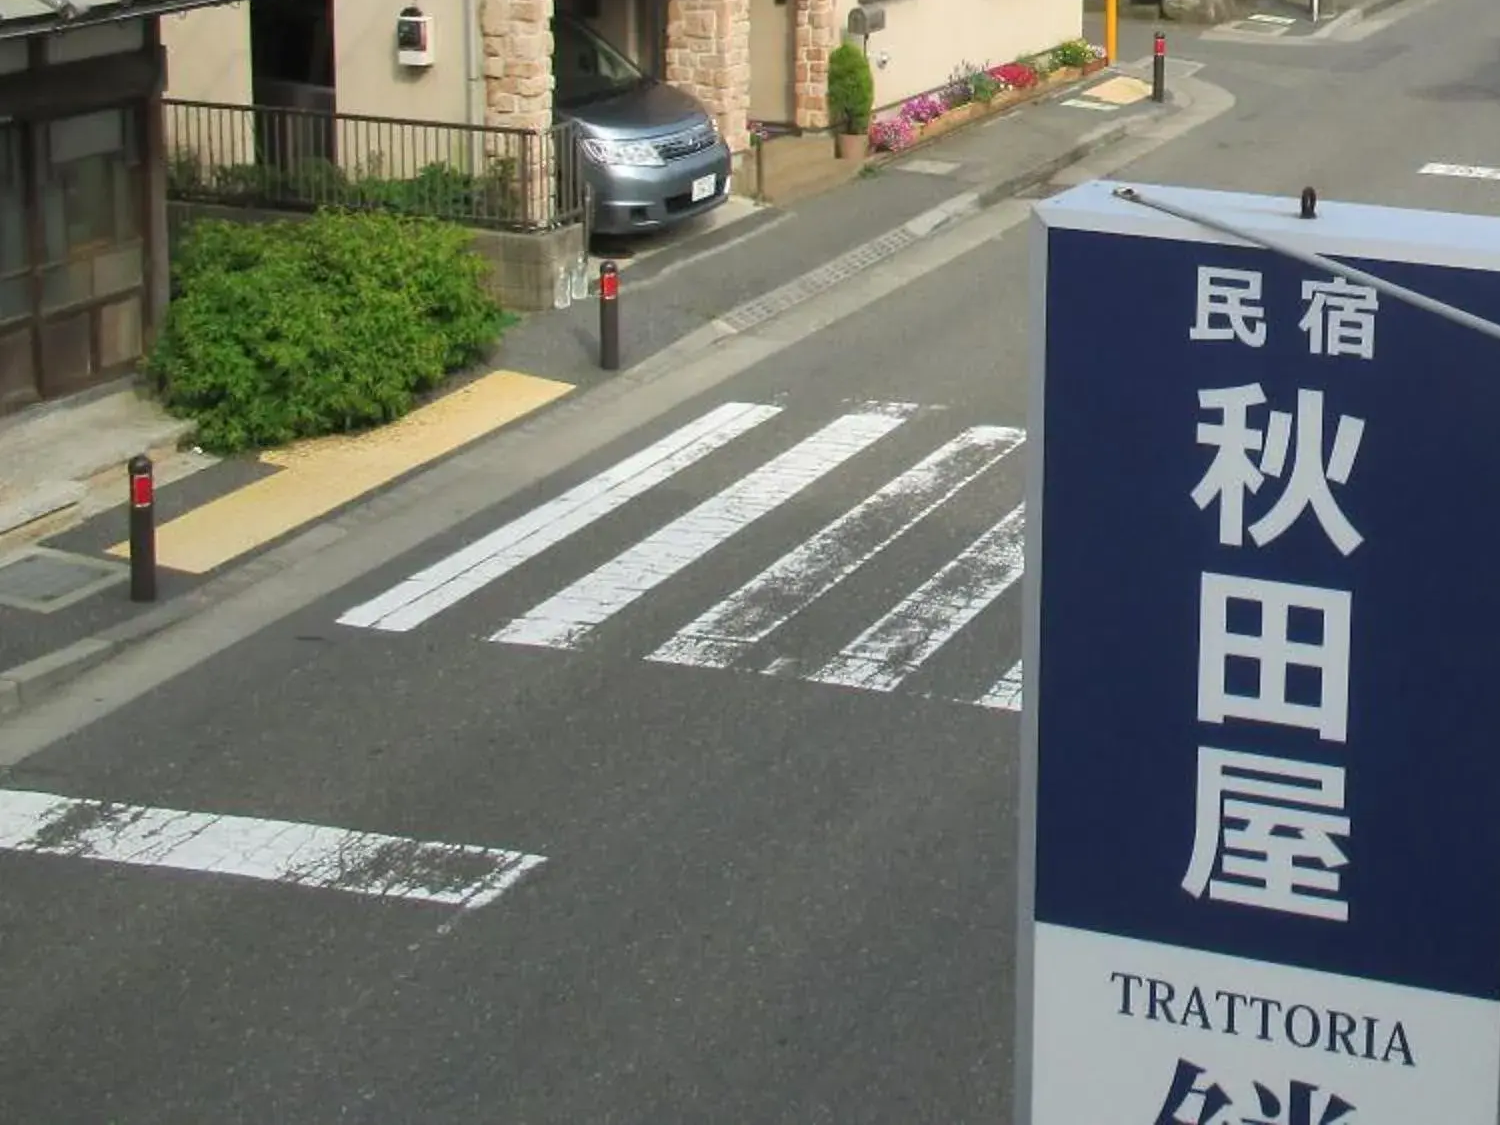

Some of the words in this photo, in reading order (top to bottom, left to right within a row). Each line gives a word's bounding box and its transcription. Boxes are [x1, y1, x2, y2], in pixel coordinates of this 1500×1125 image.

[1189, 265, 1380, 361] 民宿
[1182, 382, 1367, 924] 秋田屋
[1110, 971, 1416, 1068] TRATTORIA
